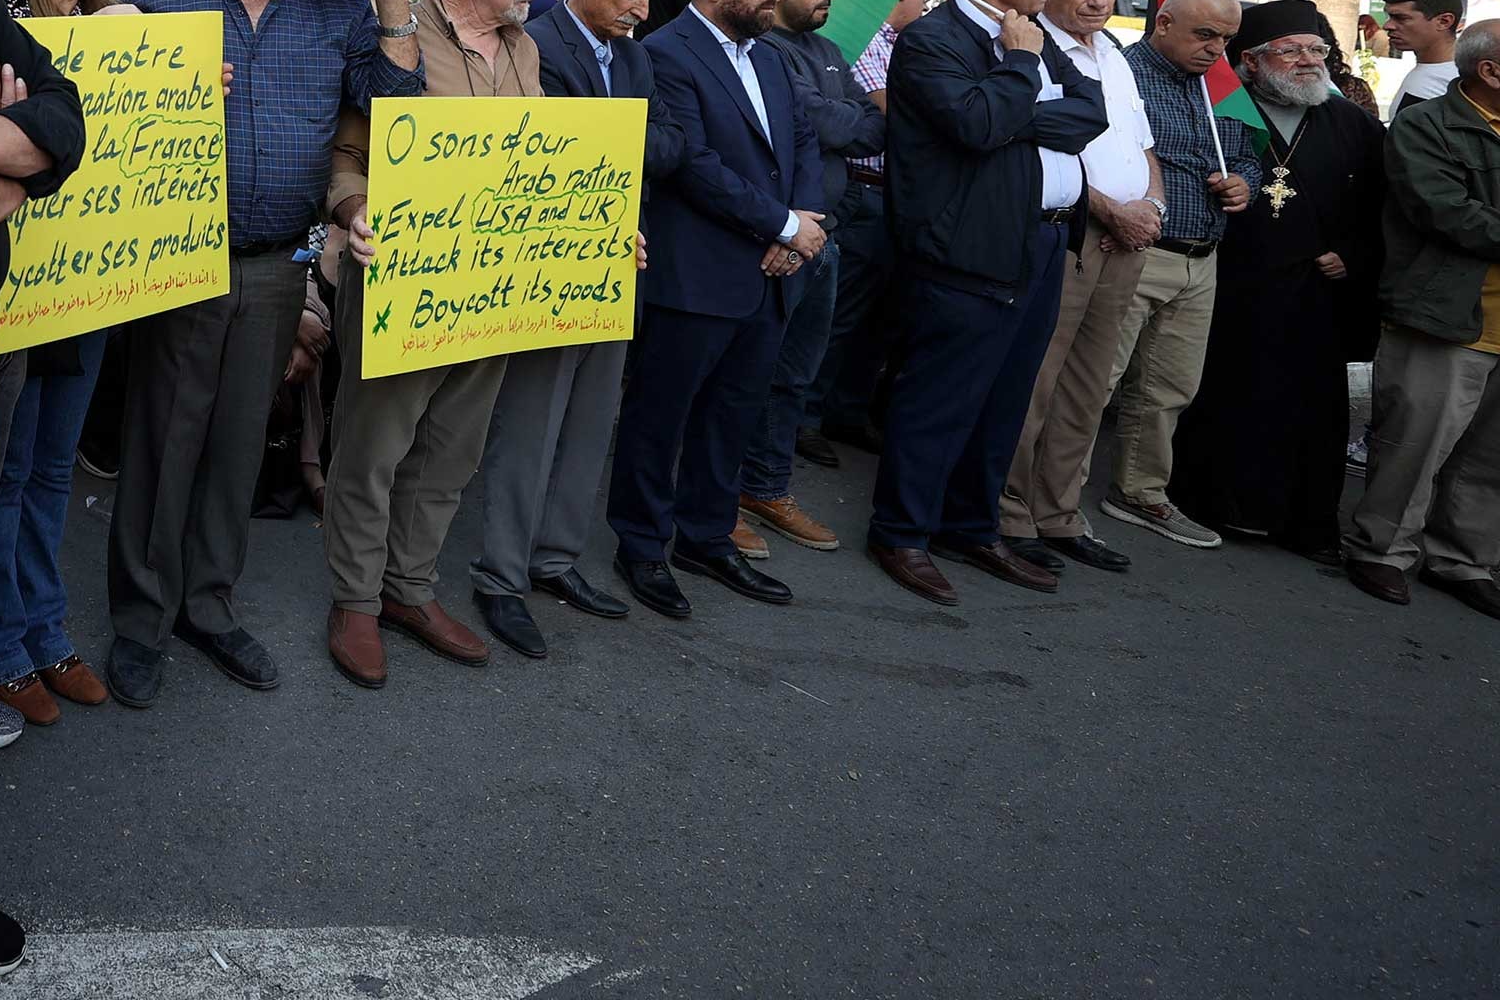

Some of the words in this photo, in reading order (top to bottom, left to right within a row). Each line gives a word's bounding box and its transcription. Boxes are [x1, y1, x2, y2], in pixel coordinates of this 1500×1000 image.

[53, 27, 84, 77] de
[97, 28, 186, 74] notre
[81, 78, 149, 118] nation
[155, 70, 214, 112] arabe
[92, 123, 122, 163] la
[128, 120, 220, 166] France
[386, 113, 416, 165] O
[423, 131, 493, 163] sons
[501, 111, 531, 163] of
[525, 131, 579, 157] our
[496, 160, 557, 197] Arab
[562, 154, 633, 191] nation
[7, 191, 75, 245] quer
[78, 184, 121, 217] ses
[132, 166, 221, 209] intérêts
[380, 193, 466, 244] Expel
[475, 201, 533, 232] USA
[538, 190, 573, 223] and
[578, 194, 617, 225] UK
[5, 239, 94, 312] ycotter
[96, 237, 140, 276] ses
[144, 213, 226, 276] produits
[380, 235, 462, 285] Attack
[470, 236, 504, 272] its
[514, 227, 634, 265] interests
[410, 273, 515, 331] Boycott
[521, 268, 553, 306] its
[552, 267, 623, 317] goods
